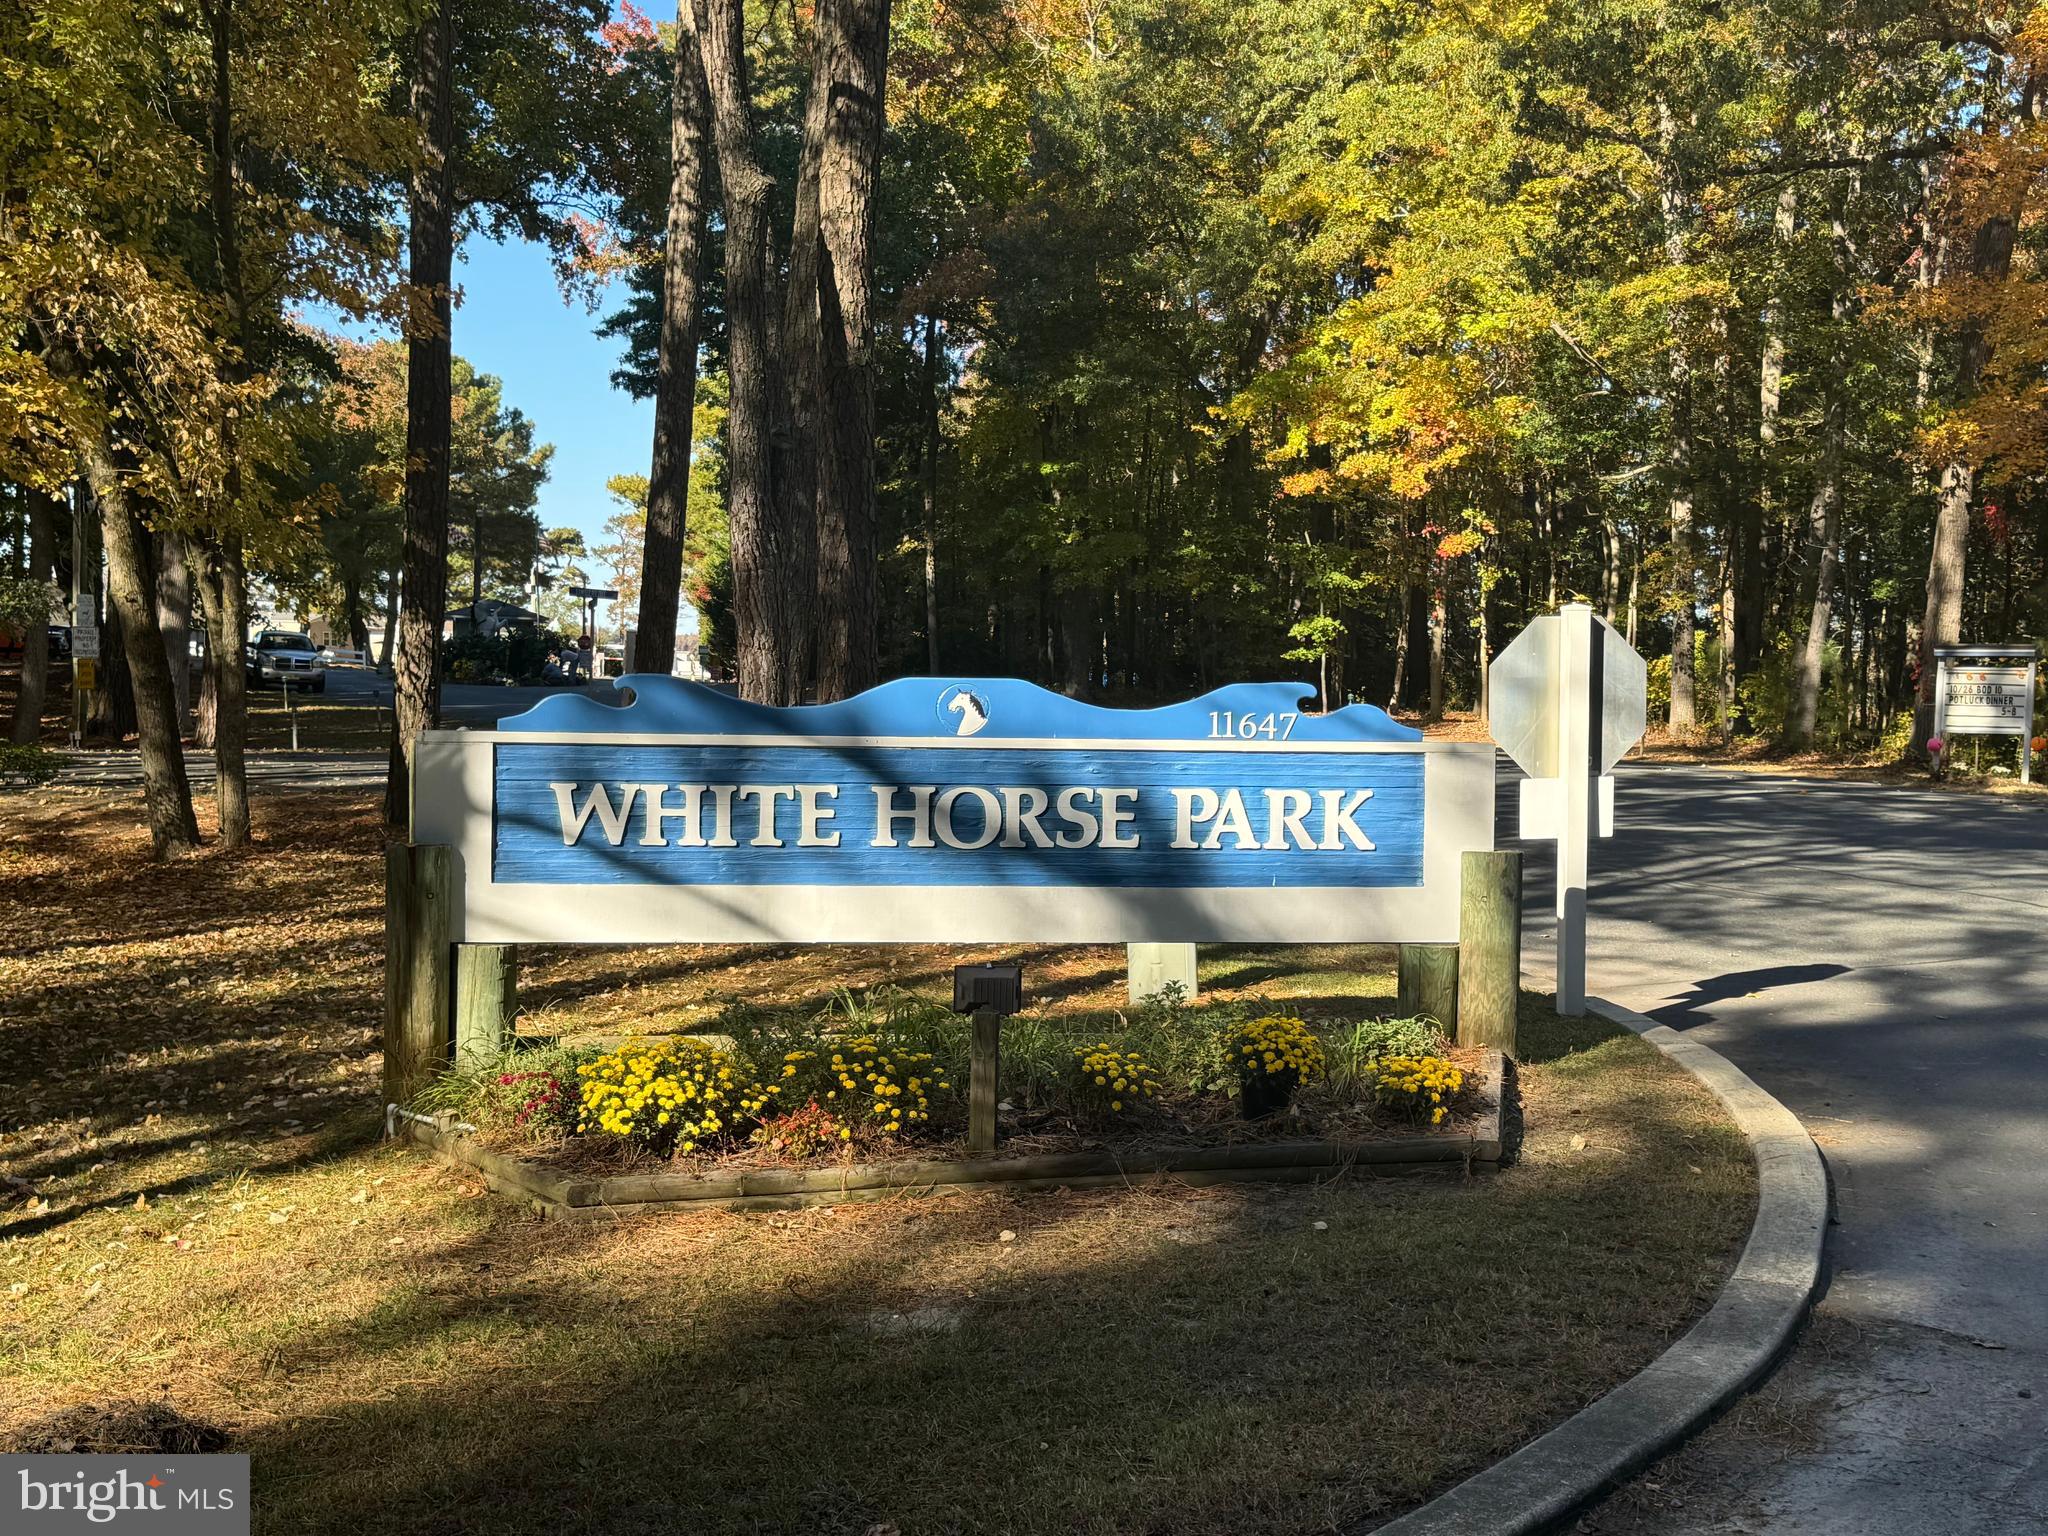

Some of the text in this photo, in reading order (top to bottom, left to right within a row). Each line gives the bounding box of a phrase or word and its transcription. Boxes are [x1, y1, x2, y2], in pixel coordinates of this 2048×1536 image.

[1950, 685, 1973, 693] 10/26
[1948, 695, 2014, 705] POTLUCK DINNER
[1207, 711, 1299, 741] 11647
[549, 782, 1377, 851] WHITE HORSE PARK
